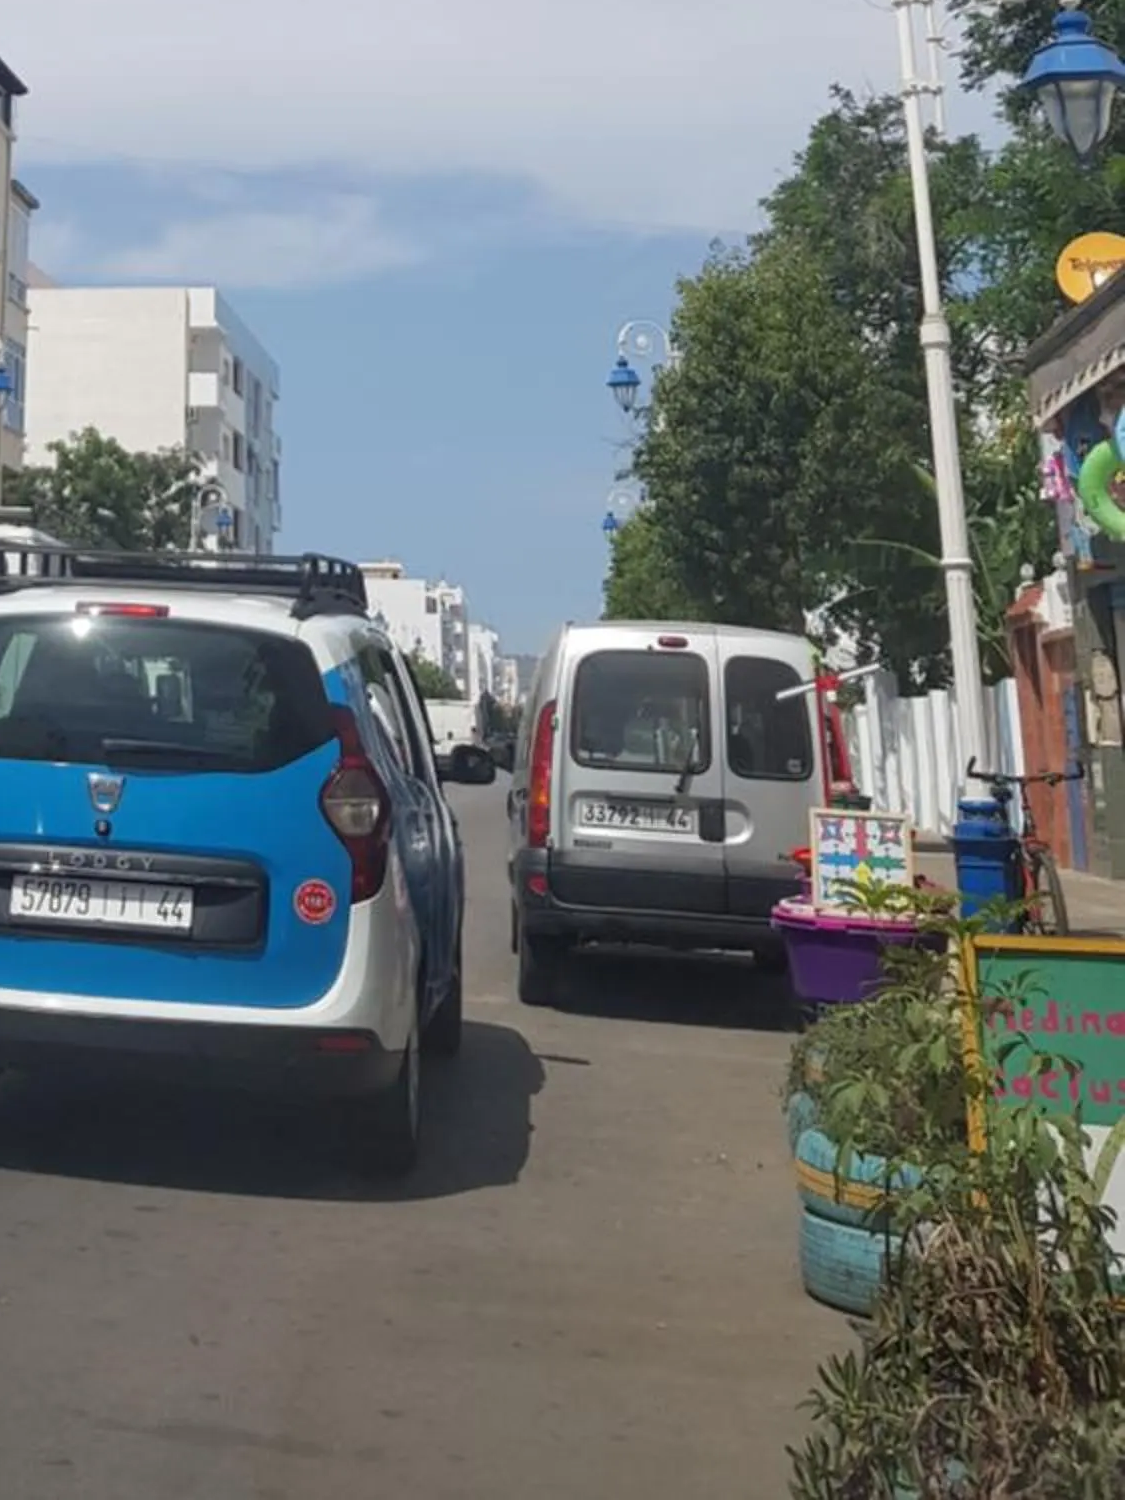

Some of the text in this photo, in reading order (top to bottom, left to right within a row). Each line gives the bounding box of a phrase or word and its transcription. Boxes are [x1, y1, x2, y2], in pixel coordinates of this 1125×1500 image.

[46, 851, 154, 870] LODGY
[21, 878, 91, 915] 57879
[156, 889, 185, 922] 44
